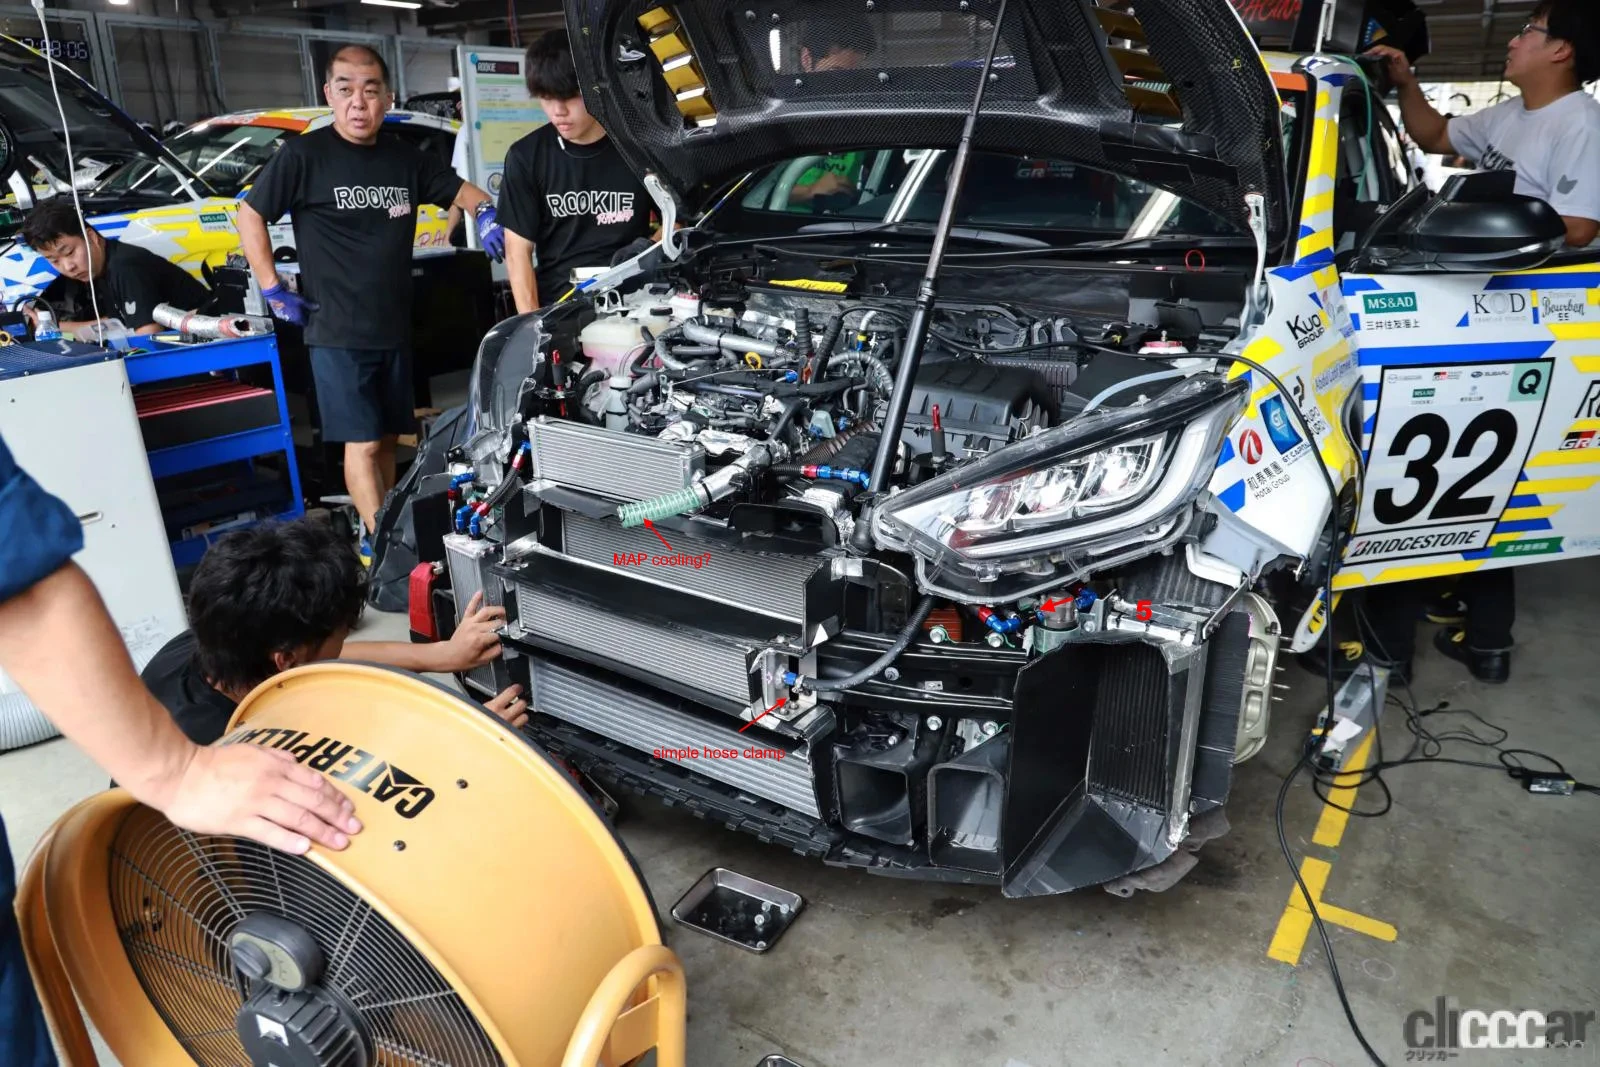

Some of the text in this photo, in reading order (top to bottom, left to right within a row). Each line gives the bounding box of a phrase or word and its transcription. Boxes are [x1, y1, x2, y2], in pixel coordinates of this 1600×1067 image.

[333, 186, 409, 209] ROOKIE
[546, 190, 634, 217] ROOKIE
[1367, 296, 1414, 309] MS&AD
[1297, 327, 1325, 349] GROUP
[1517, 368, 1543, 395] Q
[1373, 408, 1518, 525] 32
[1350, 529, 1481, 558] BRIDGESTONE
